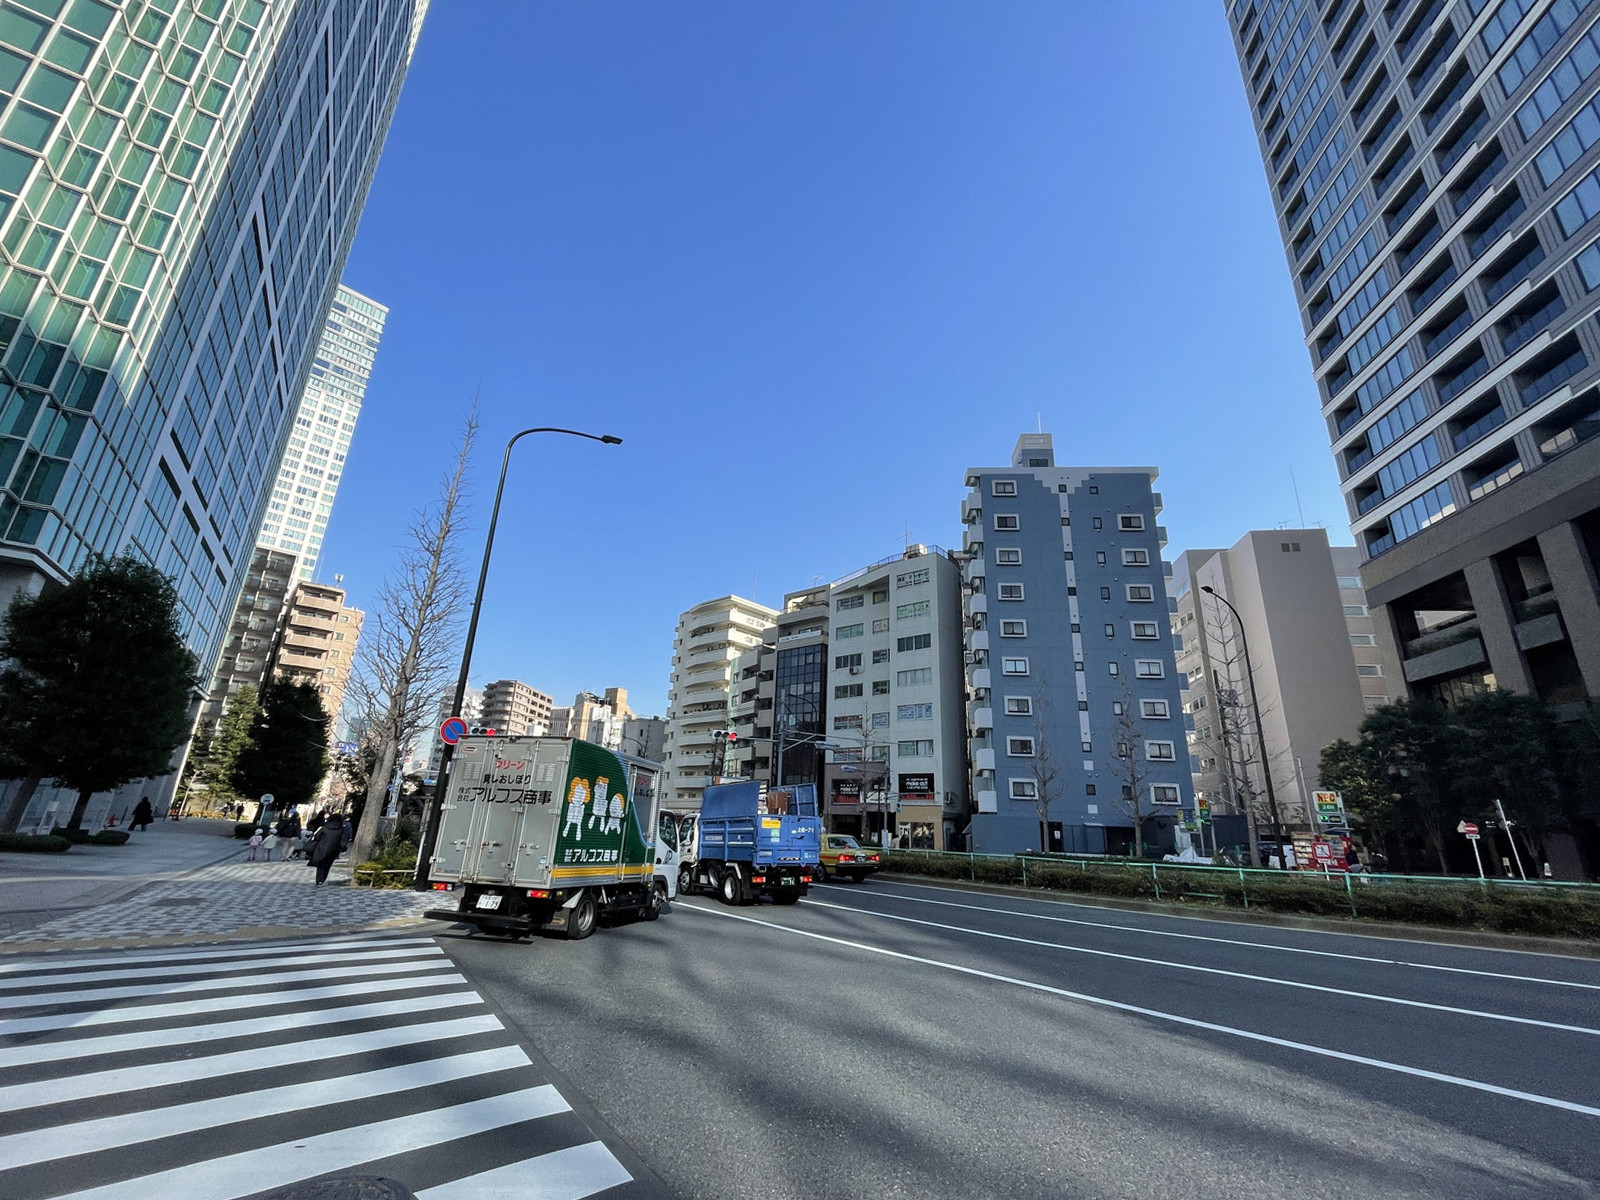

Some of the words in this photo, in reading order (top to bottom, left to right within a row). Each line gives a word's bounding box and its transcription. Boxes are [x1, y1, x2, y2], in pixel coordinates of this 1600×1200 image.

[483, 774, 532, 785] 貸しおしぼり
[470, 787, 553, 805] アルコス商事
[1317, 793, 1336, 803] NPC
[572, 849, 618, 862] アルコス商事
